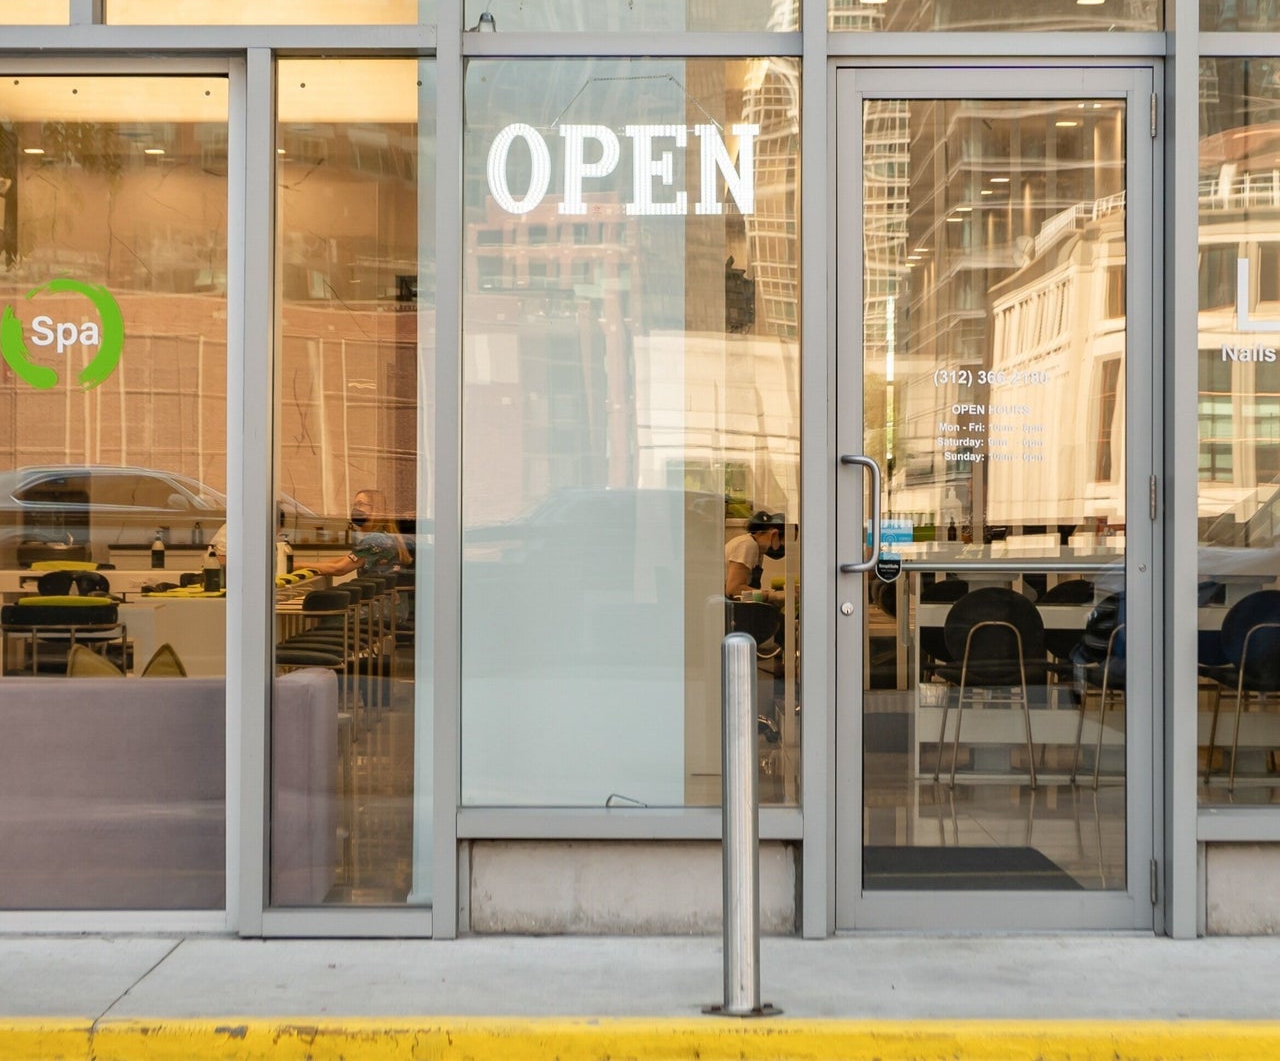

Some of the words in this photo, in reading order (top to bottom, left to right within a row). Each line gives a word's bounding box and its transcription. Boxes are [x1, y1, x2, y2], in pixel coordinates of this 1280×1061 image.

[486, 122, 760, 215] OPEN
[30, 315, 100, 354] Spa
[1221, 344, 1277, 363] Nails
[933, 369, 973, 388] (312)
[951, 404, 985, 415] OPEN
[988, 404, 1031, 416] HOURS
[938, 422, 960, 432] Mon
[968, 422, 985, 432] Fri:
[937, 437, 984, 449] Saturday:
[944, 451, 985, 463] Sunday:
